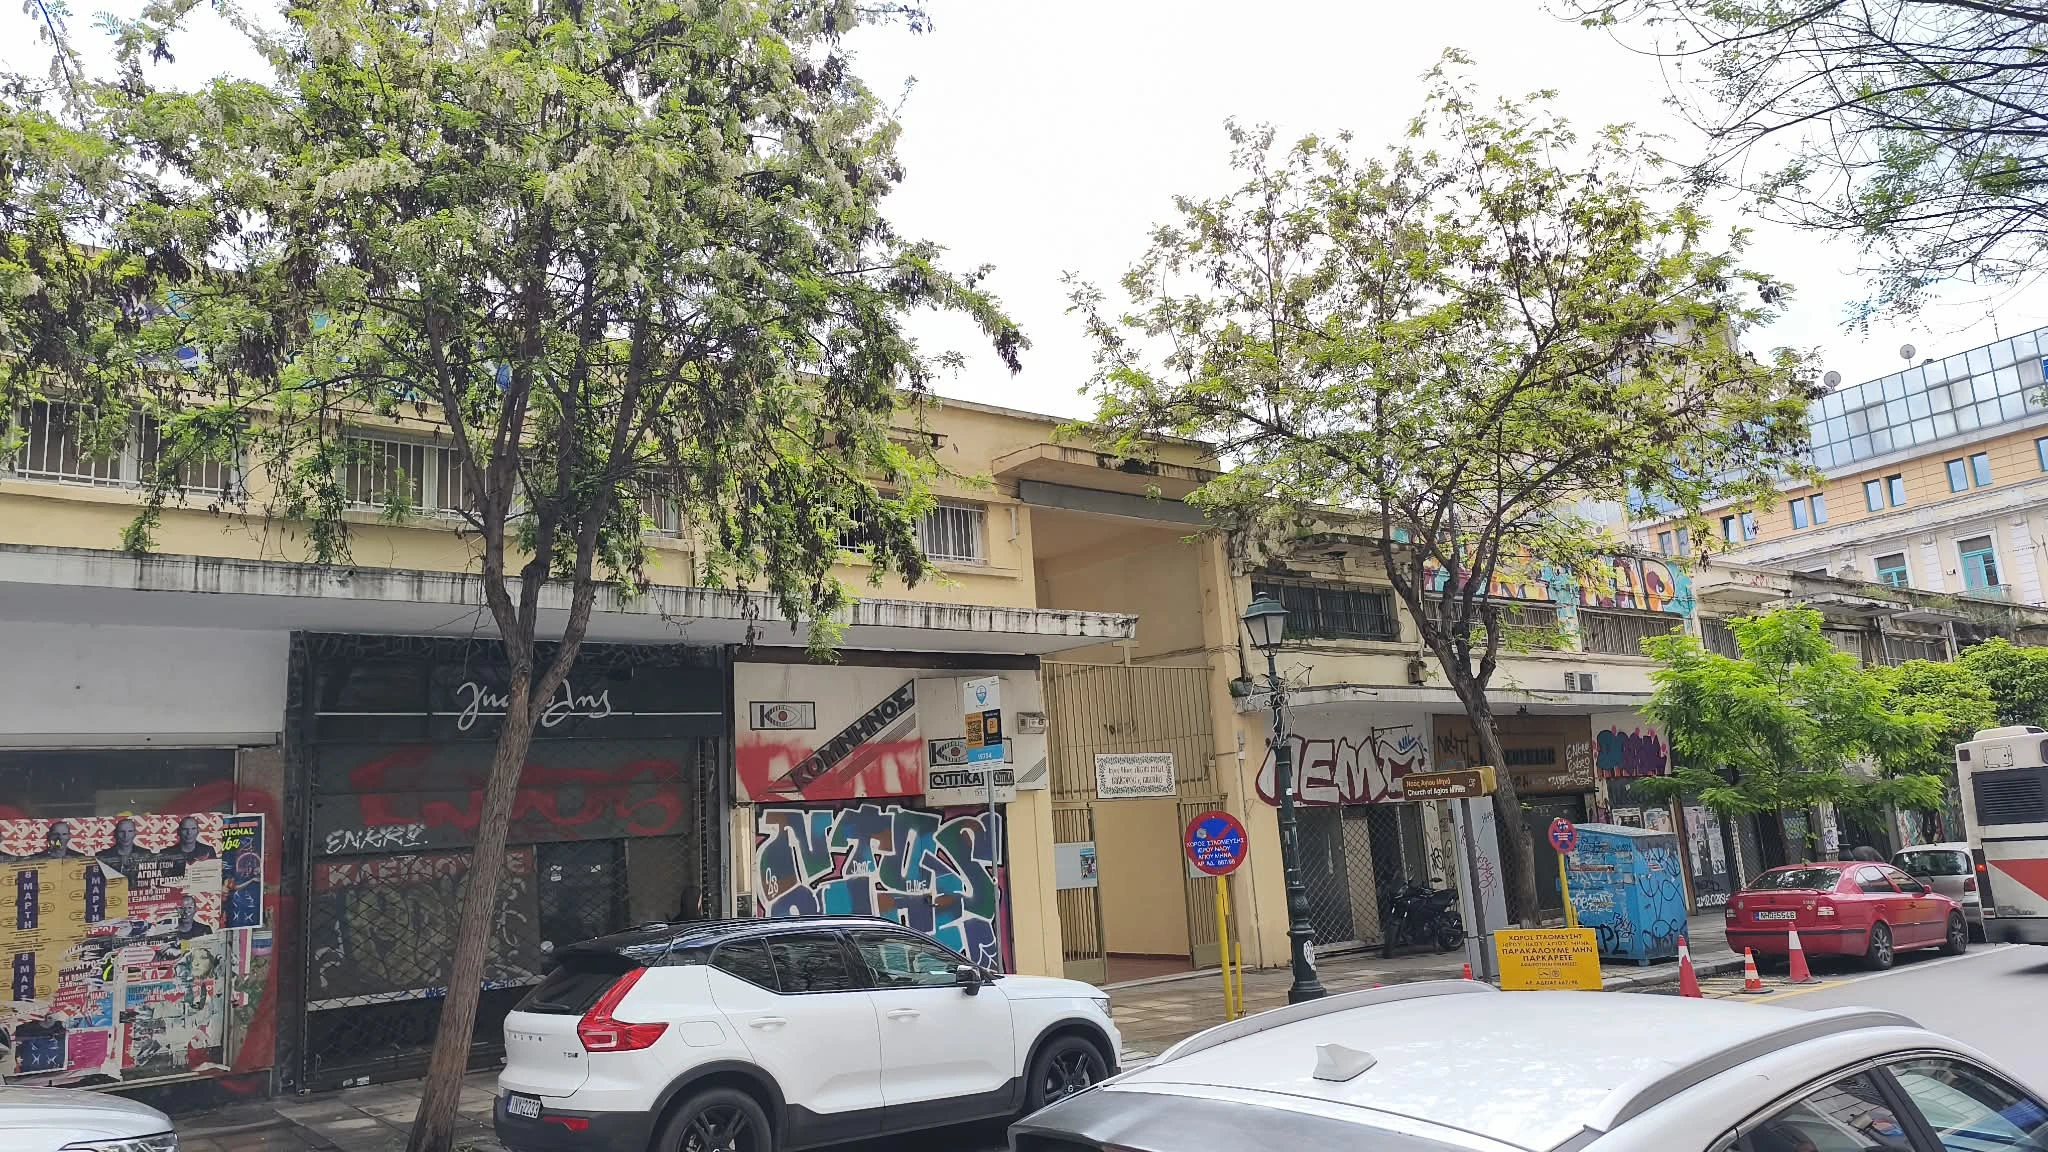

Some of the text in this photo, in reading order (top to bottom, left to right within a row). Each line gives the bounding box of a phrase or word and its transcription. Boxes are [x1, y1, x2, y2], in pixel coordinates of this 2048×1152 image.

[790, 686, 913, 792] ΚΟΜΝΗΝΟΣ
[932, 772, 981, 787] ΟΠΤΙΚΑ
[1407, 788, 1427, 797] Church
[1427, 787, 1433, 795] of
[1434, 786, 1448, 796] Agios
[222, 827, 254, 837] TIONAL
[138, 861, 157, 871] ΝΙΚΗ
[328, 851, 526, 888] ΚΛΕΙΝΟΥΕ
[1535, 933, 1582, 941] ΣΤΑΘΜΕΥΣΗΣ
[1502, 947, 1570, 955] ΠΑΡΑΚΑΛΟΥΜΕ
[1523, 954, 1573, 962] ΠΑΡΚΑΡΕΤΕ
